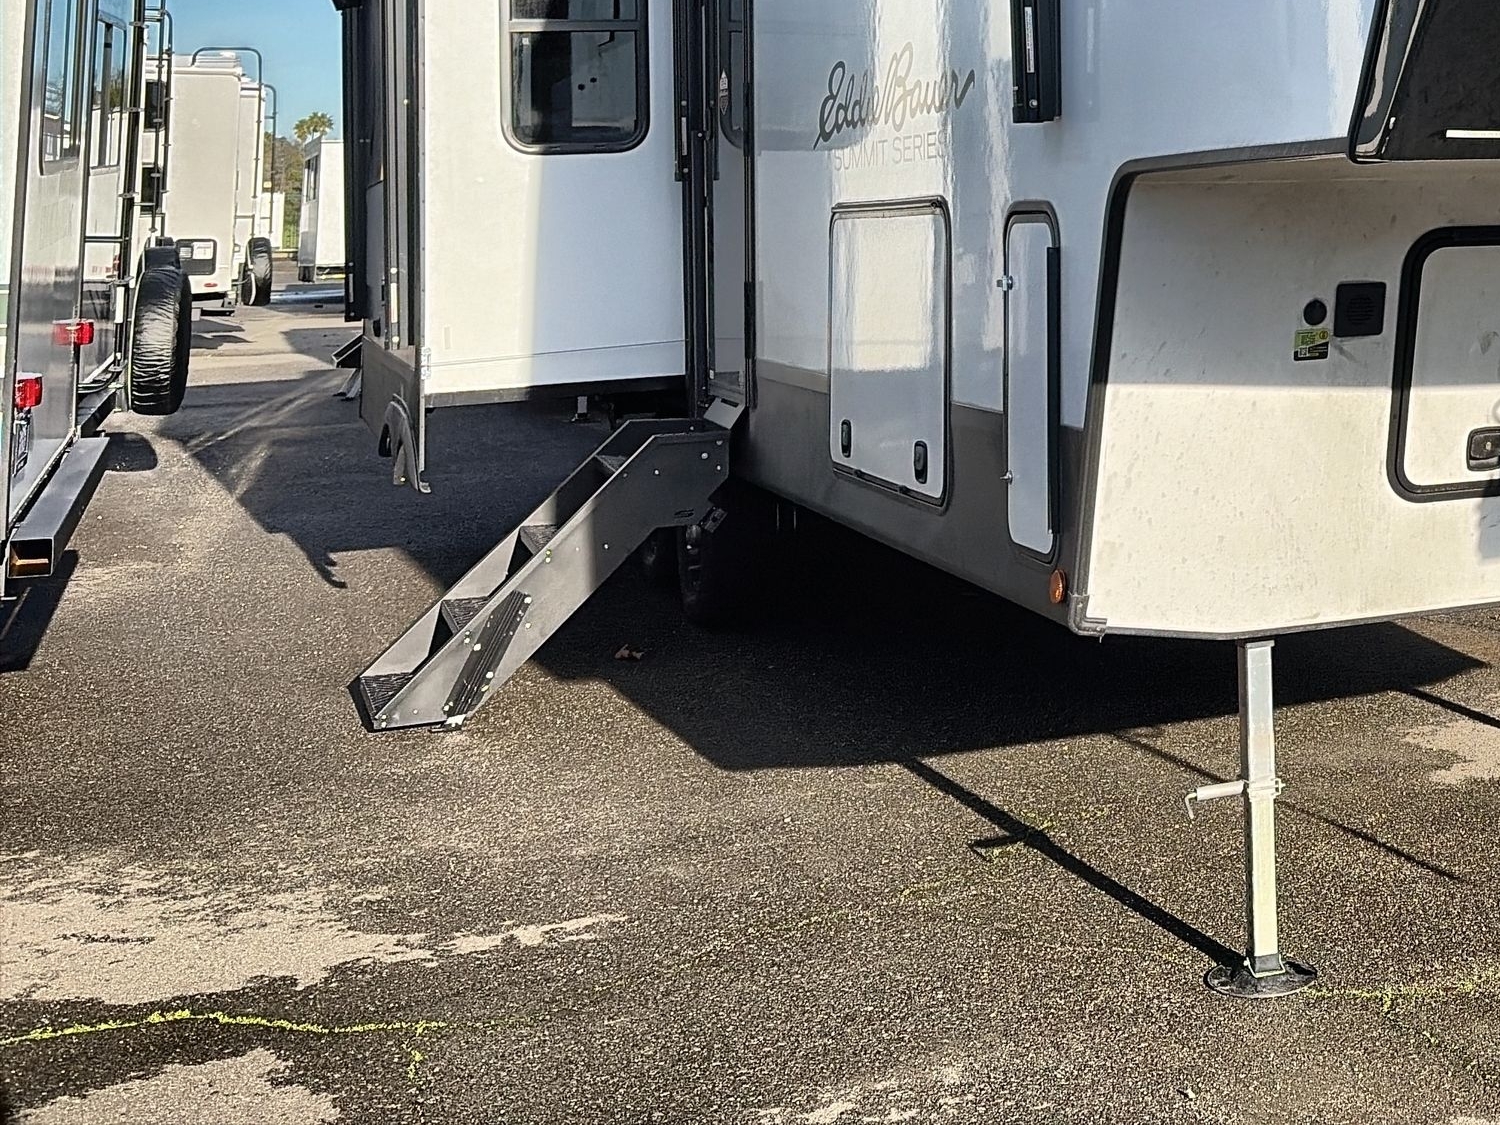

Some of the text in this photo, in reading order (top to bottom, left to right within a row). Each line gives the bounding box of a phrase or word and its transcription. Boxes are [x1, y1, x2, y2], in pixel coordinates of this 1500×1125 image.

[813, 60, 882, 150] Eddie
[879, 41, 976, 133] Bauer
[834, 131, 948, 172] SUMMIT SERIES
